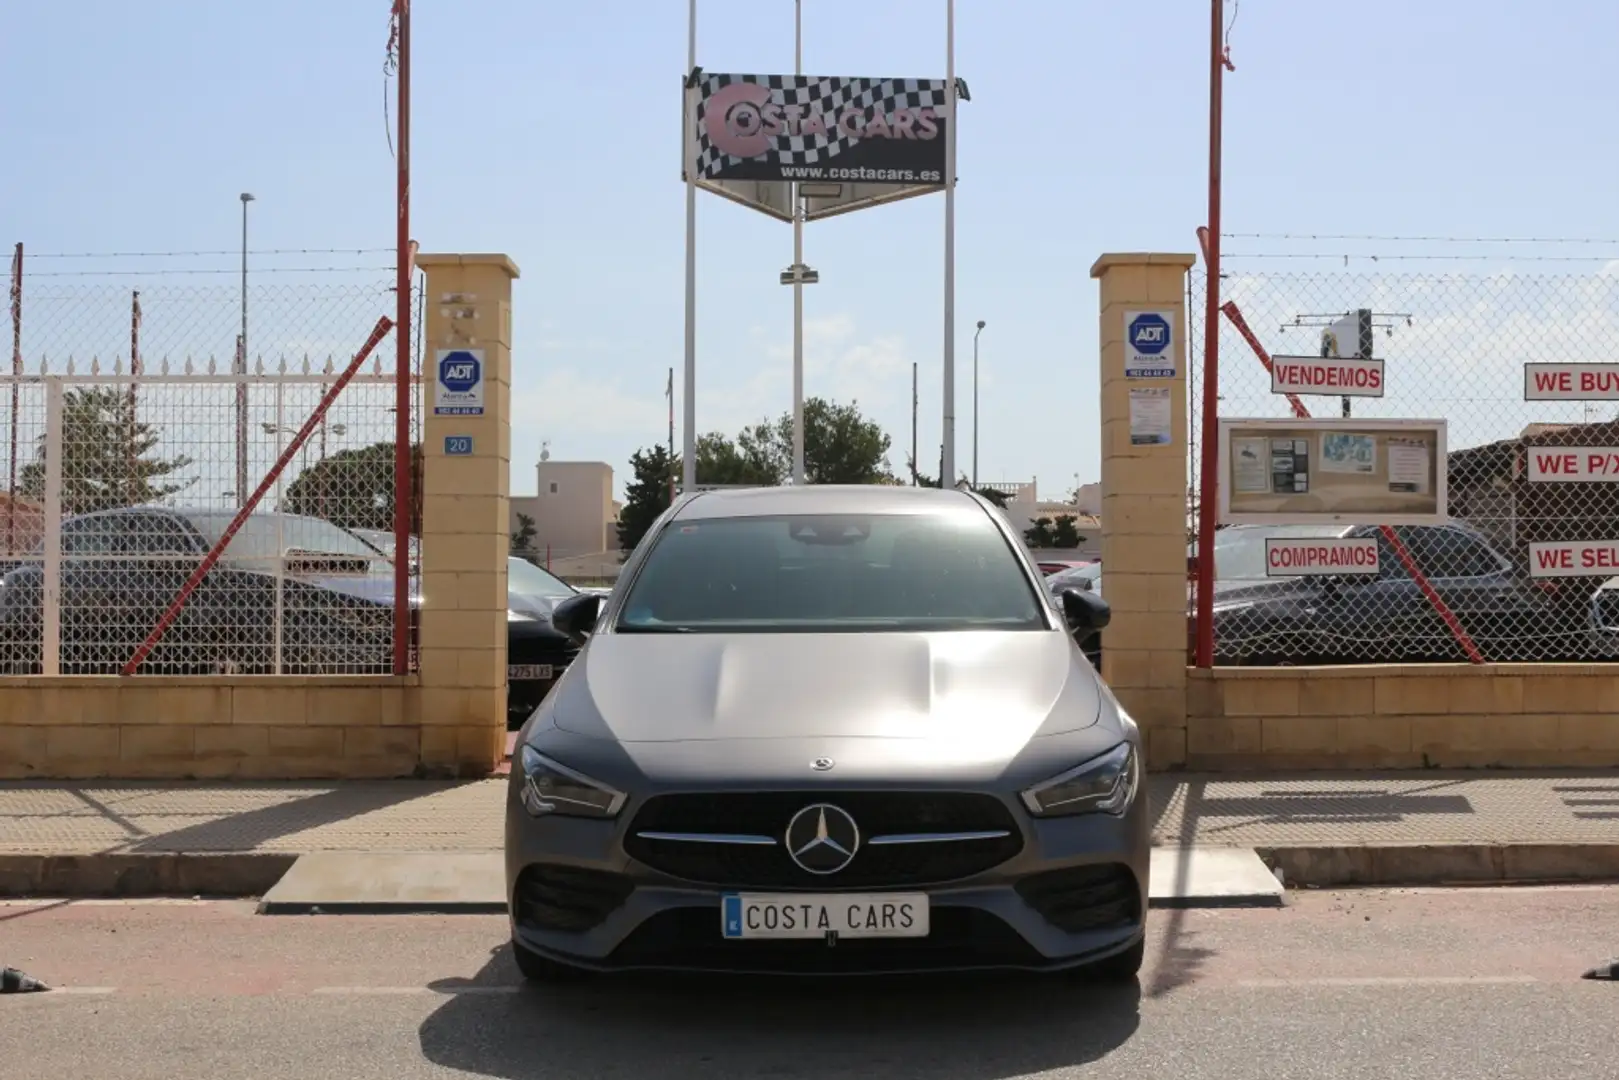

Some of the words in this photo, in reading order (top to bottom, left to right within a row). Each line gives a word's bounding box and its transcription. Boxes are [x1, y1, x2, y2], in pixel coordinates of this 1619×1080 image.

[839, 107, 939, 141] CARS
[780, 166, 941, 182] www.costacars.es
[1136, 327, 1163, 341] ADT
[446, 365, 474, 379] ADT
[1276, 365, 1381, 388] VENDEMOS
[1535, 372, 1573, 392] WE
[450, 439, 467, 451] 20
[1536, 455, 1578, 474] WE
[1269, 546, 1377, 568] COMPRAMOS
[1537, 549, 1574, 569] WE
[746, 904, 830, 930] COSTA
[847, 903, 914, 929] CARS
